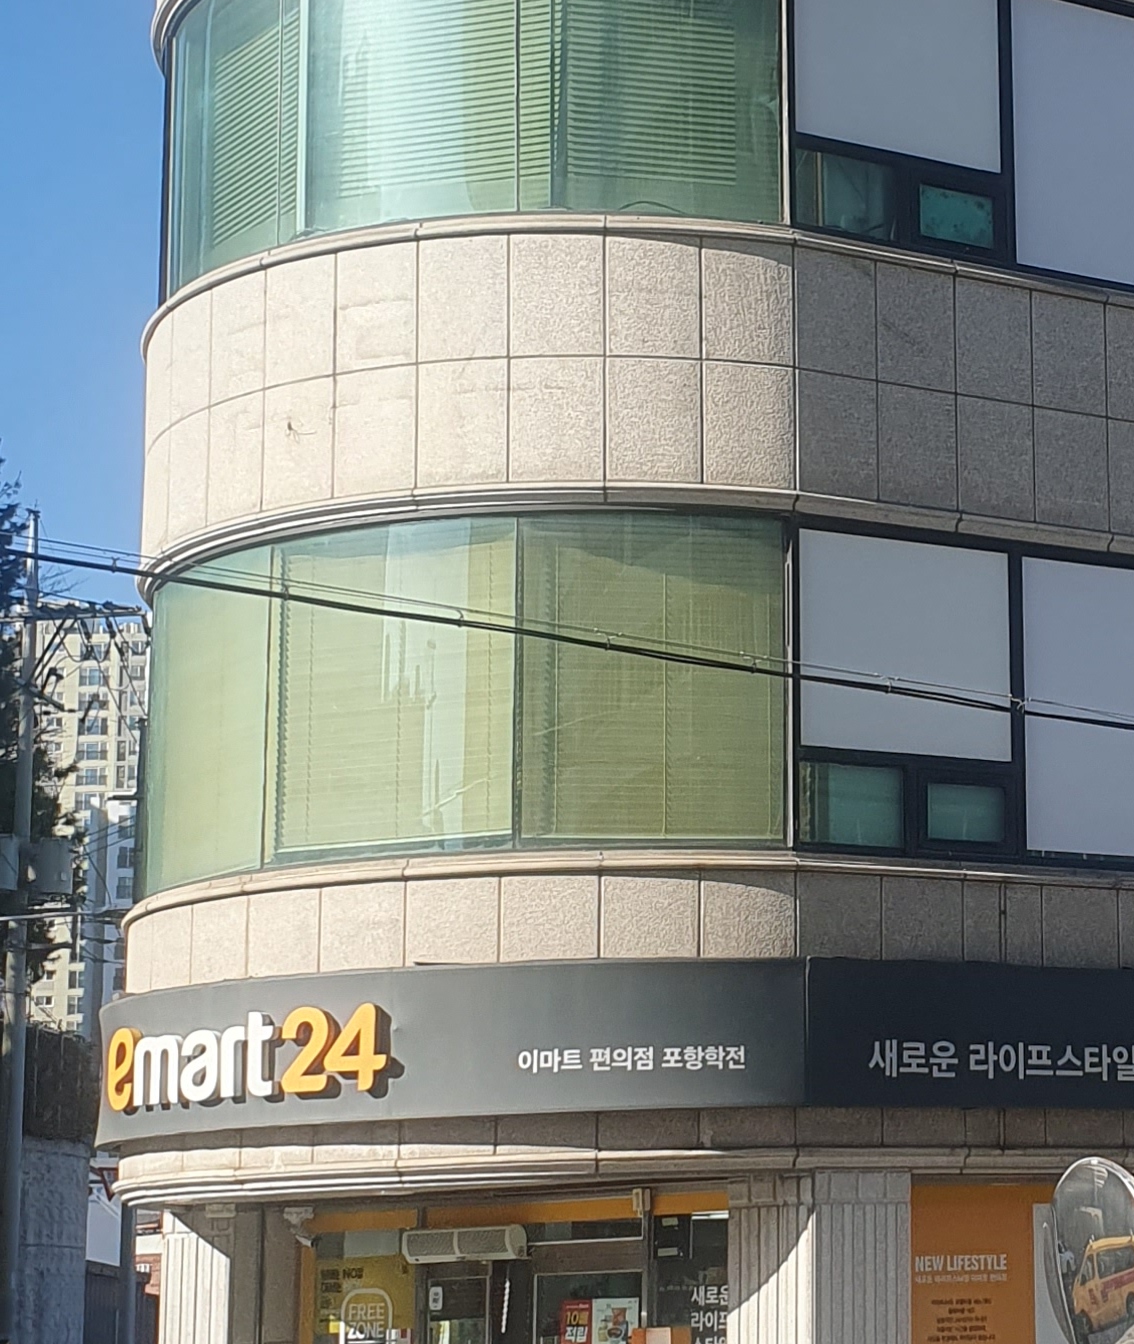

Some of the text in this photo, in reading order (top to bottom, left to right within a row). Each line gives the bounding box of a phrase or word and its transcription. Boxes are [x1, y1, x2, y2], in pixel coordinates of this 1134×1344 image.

[106, 1001, 390, 1113] emart24
[517, 1044, 746, 1074] 이마트 편의점 포항학전
[868, 1039, 959, 1079] 새로운
[915, 1253, 1008, 1273] NEW LIFESTYLE
[347, 1302, 386, 1321] FREE
[347, 1321, 386, 1339] ZONE
